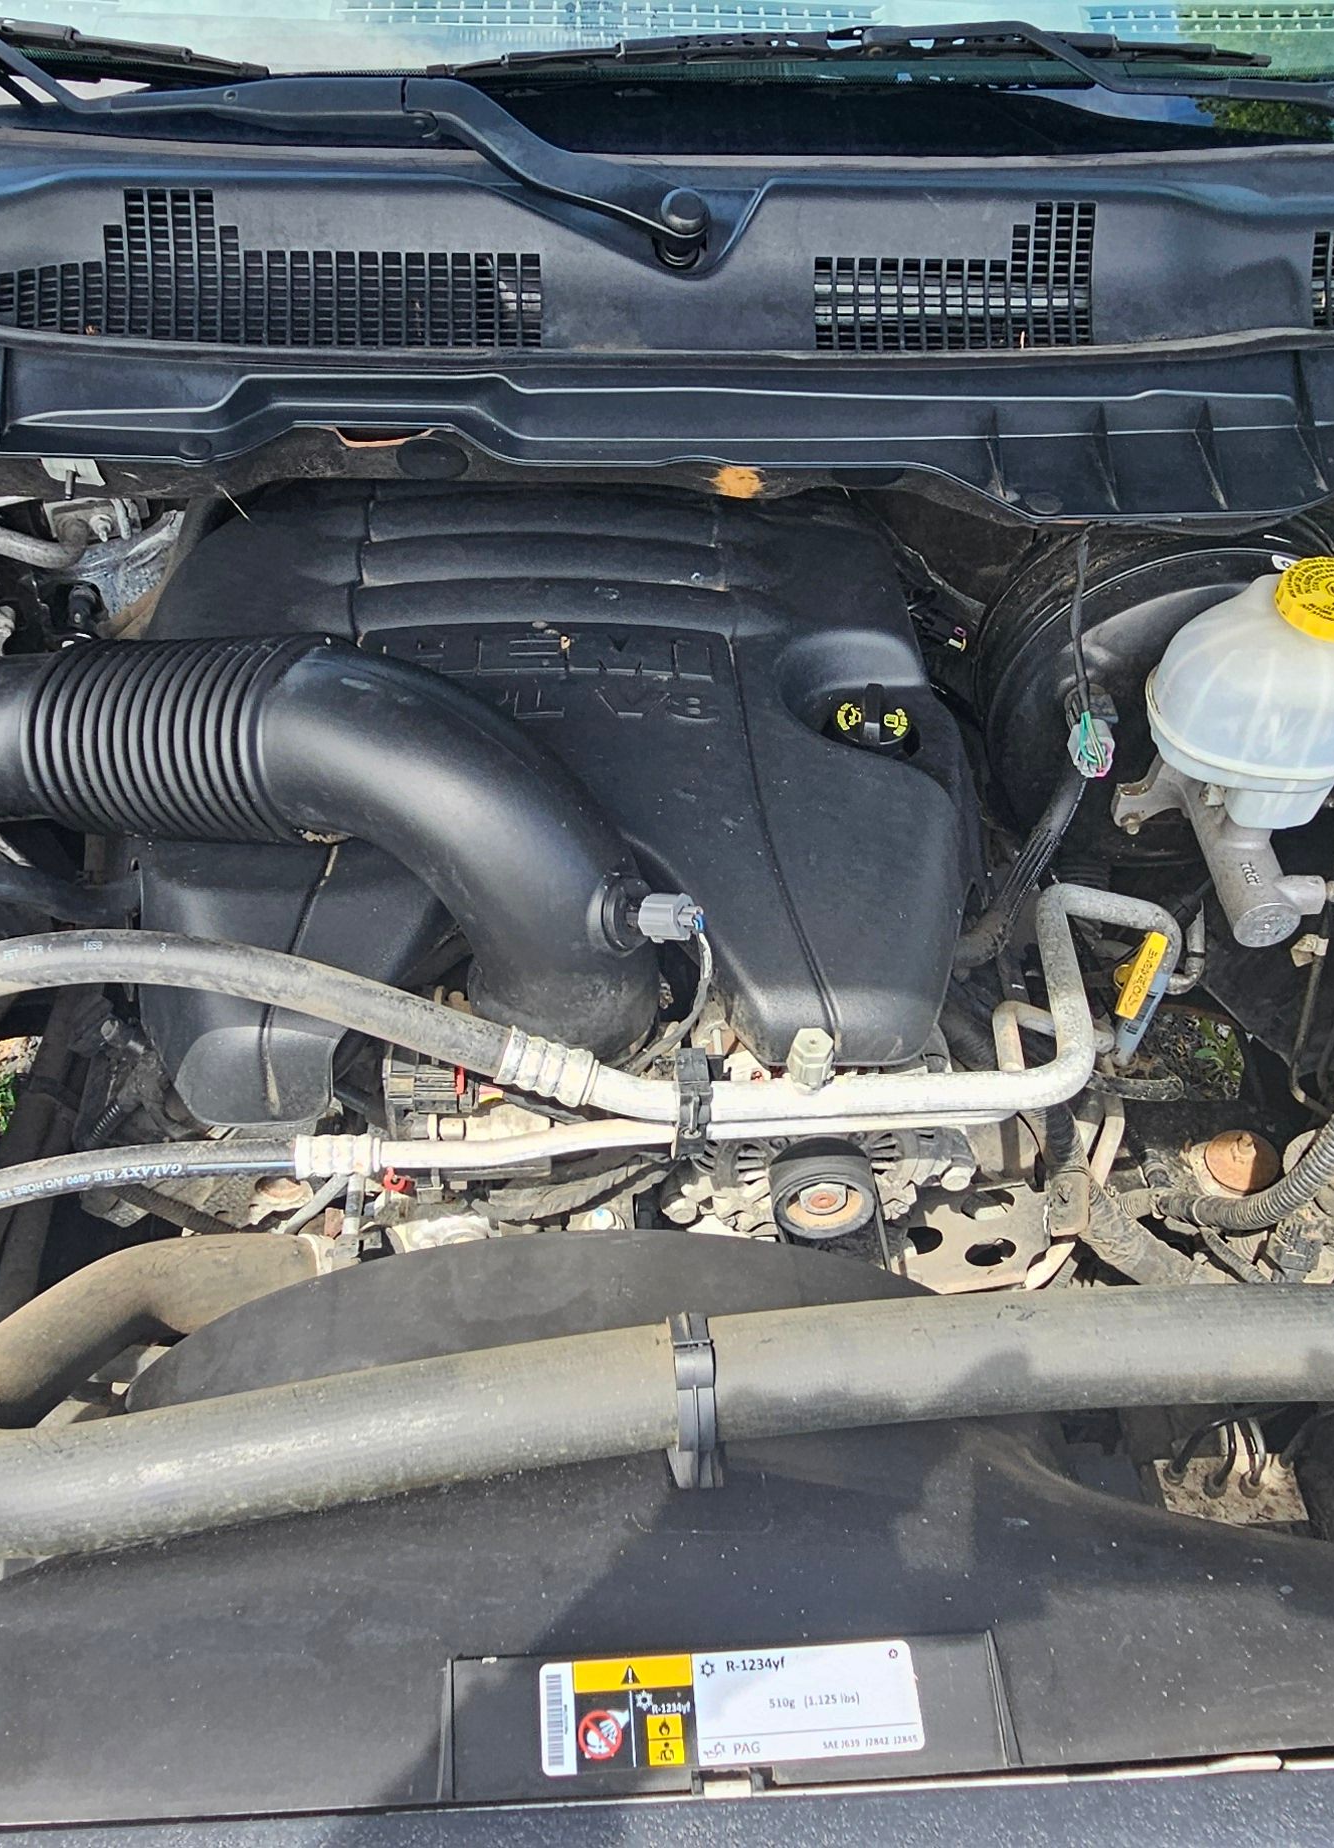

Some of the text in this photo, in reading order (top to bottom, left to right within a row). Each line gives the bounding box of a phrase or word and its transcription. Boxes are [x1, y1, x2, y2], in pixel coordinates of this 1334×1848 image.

[93, 1169, 116, 1182] SLE
[117, 1162, 183, 1179] GALAXY
[13, 1182, 45, 1195] HOSE
[45, 1176, 64, 1189] A/C
[726, 1656, 786, 1673] R-1234yf
[768, 1691, 860, 1710] 510g (1.125 lbs)
[651, 1701, 691, 1715] R-1234yf
[733, 1741, 761, 1756] PAG
[823, 1740, 839, 1750] SAE
